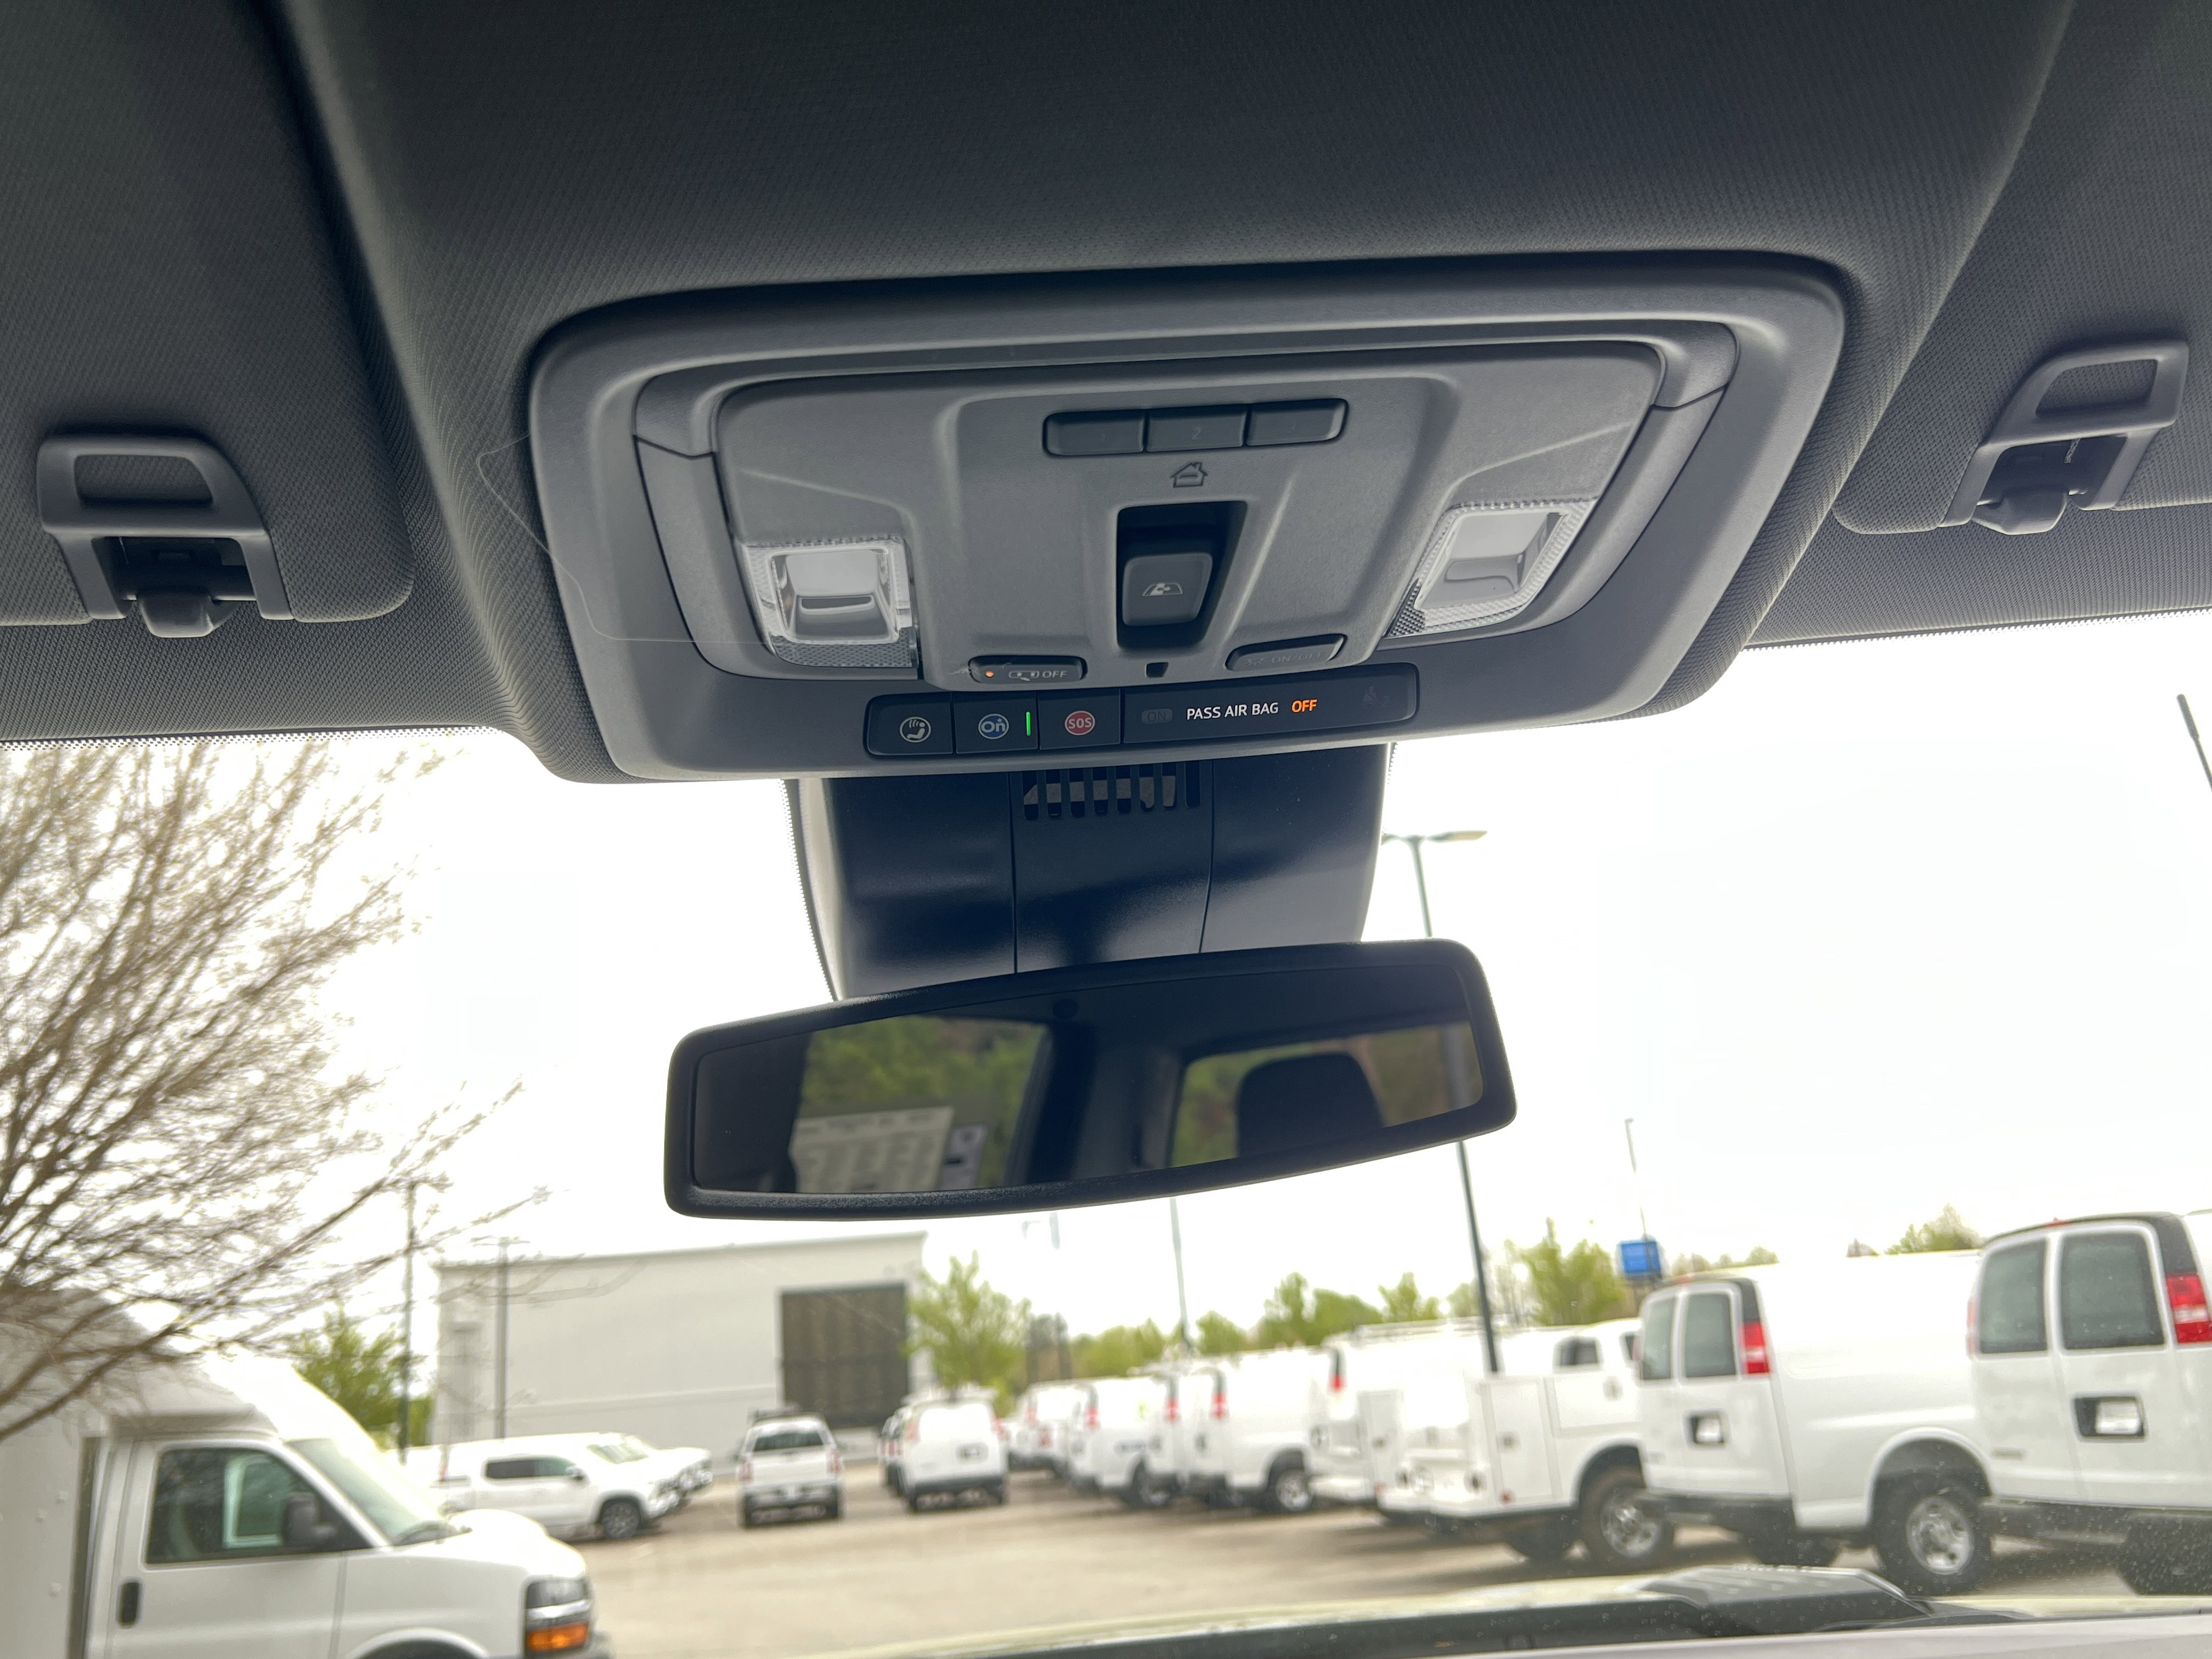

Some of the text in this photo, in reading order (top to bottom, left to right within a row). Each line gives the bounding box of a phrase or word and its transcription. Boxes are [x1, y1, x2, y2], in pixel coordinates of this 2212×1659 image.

[1042, 670, 1068, 679] OFF
[1187, 699, 1318, 720] PASS AIR BAG OFF
[1148, 711, 1166, 722] ON
[980, 720, 1006, 733] On
[1068, 717, 1092, 729] SOS
